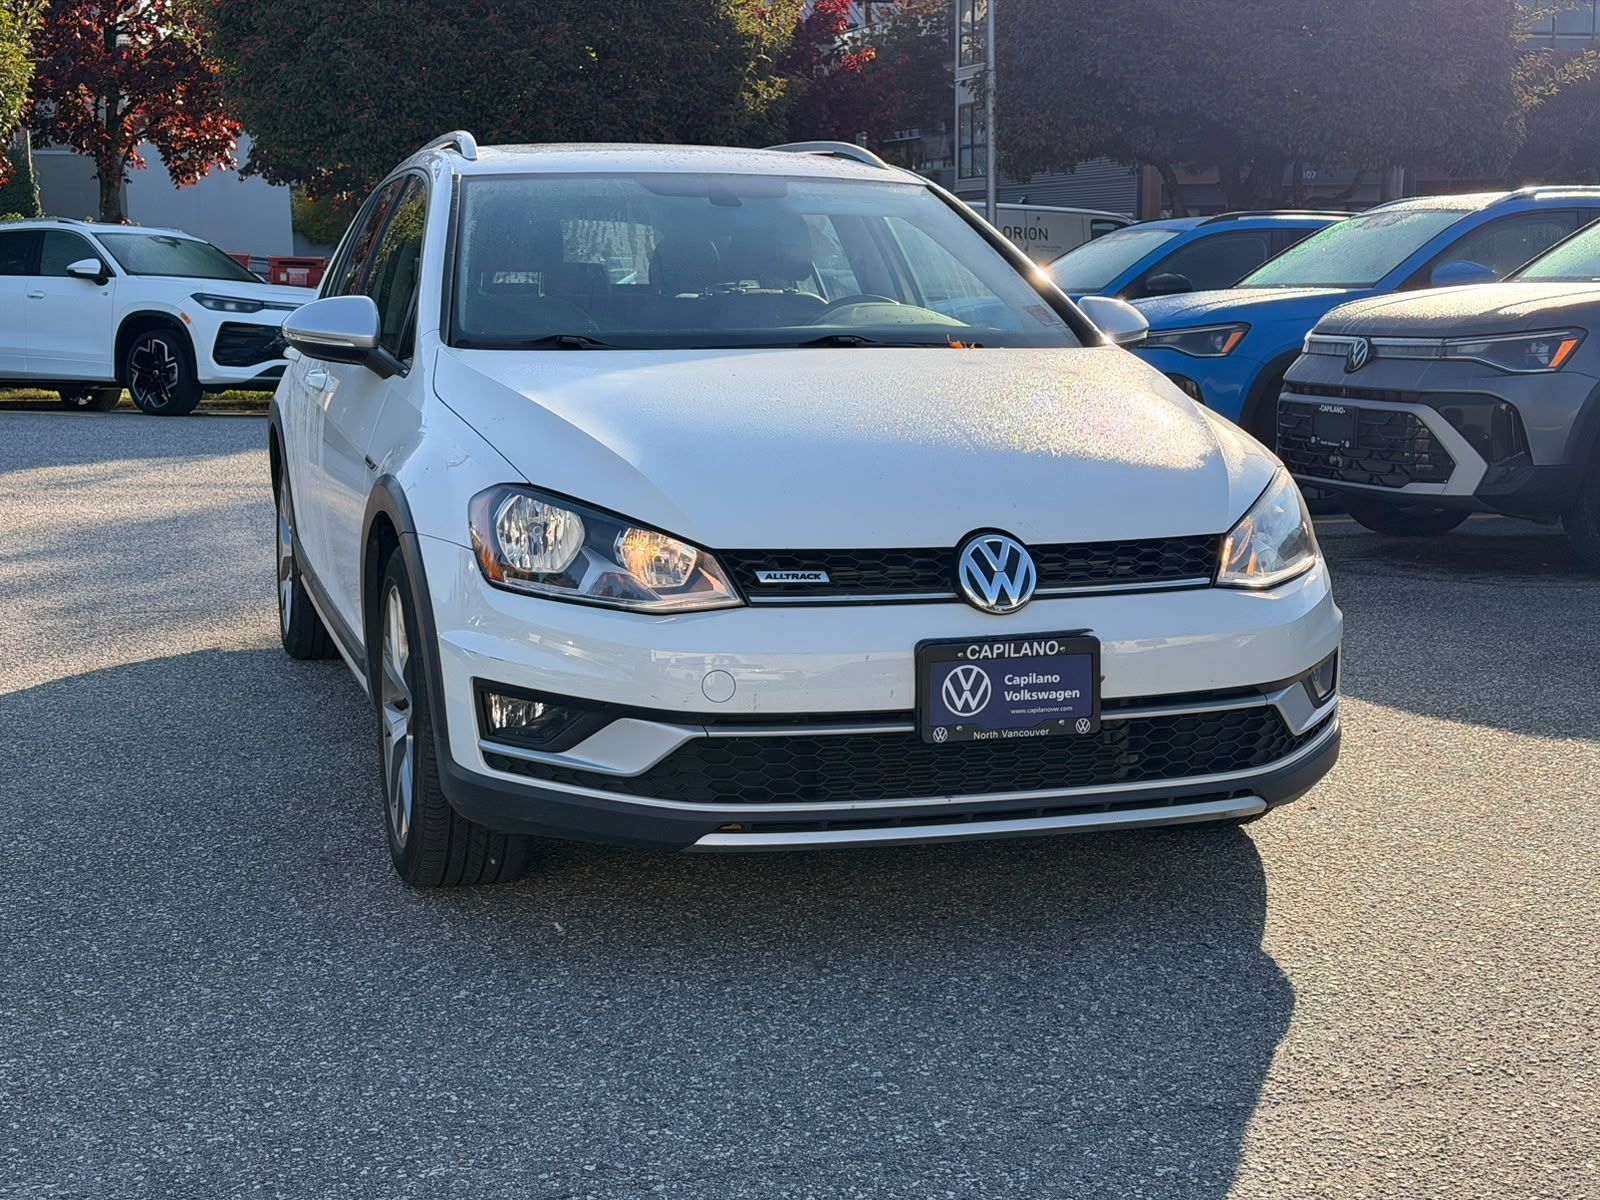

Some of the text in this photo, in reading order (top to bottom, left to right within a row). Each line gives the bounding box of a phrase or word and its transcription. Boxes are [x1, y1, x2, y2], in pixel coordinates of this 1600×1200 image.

[1002, 226, 1048, 241] ORION
[1320, 404, 1344, 414] CAPILANO
[966, 641, 1059, 660] CAPILANO
[1004, 672, 1061, 687] Capilano
[1003, 689, 1081, 702] Volkswagen
[1010, 706, 1073, 714] www.capilanovw.com
[973, 728, 1050, 741] North Vancouver
